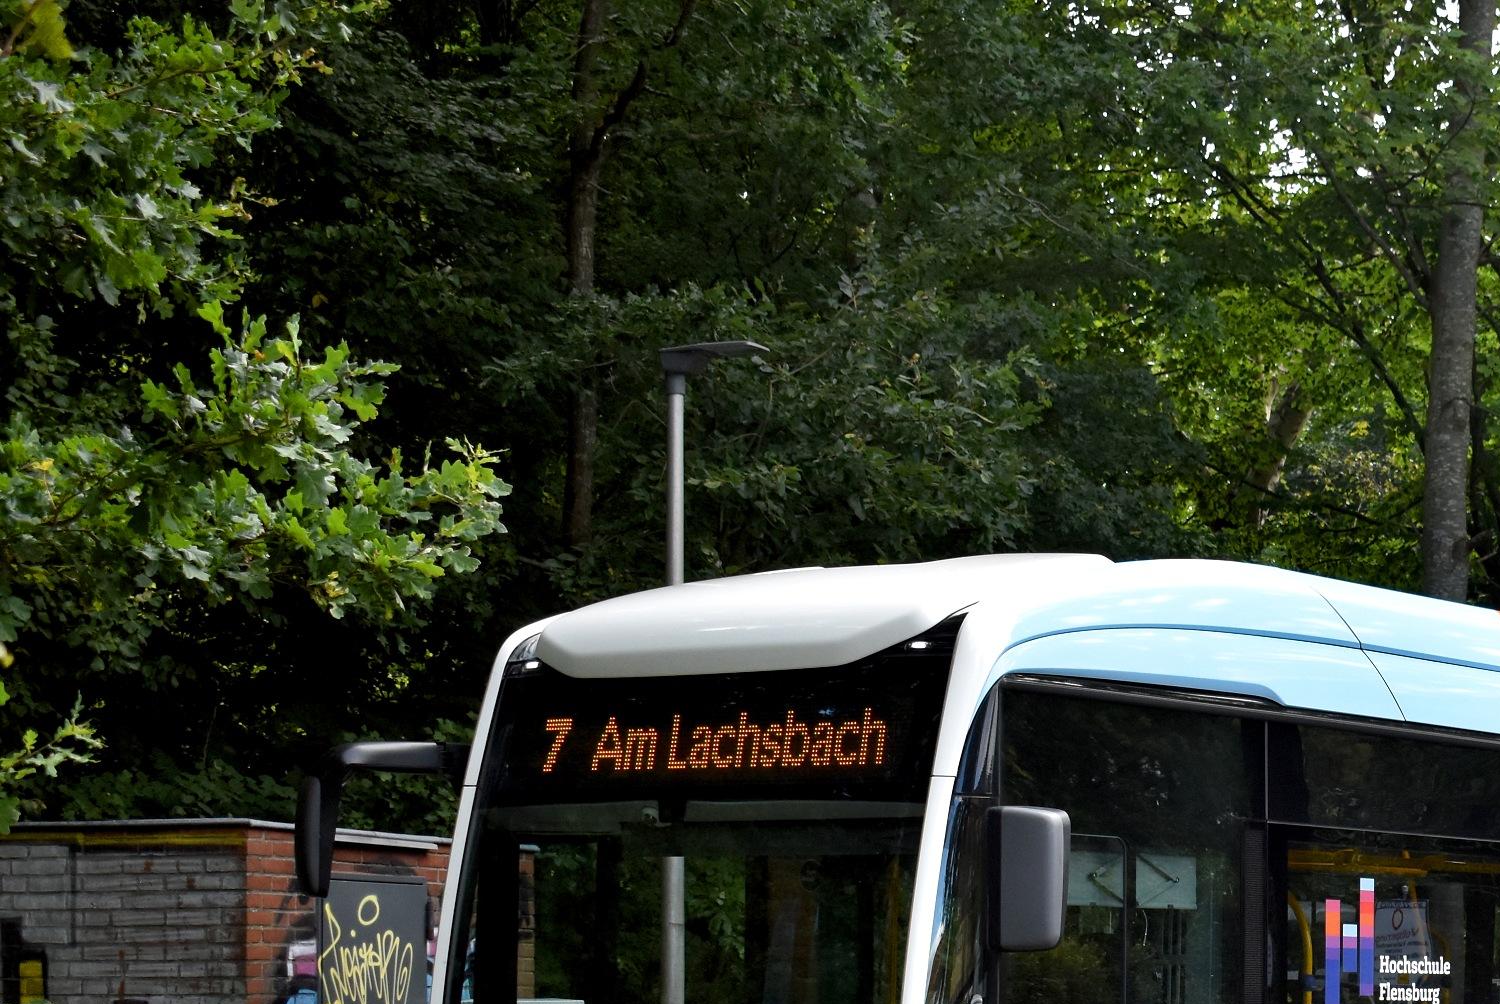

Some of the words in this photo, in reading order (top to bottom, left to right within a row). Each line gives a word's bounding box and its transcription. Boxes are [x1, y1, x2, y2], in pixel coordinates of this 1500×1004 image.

[543, 718, 573, 772] 7
[591, 716, 657, 771] Am
[668, 708, 886, 770] Lachsbach
[1379, 955, 1451, 975] Hochschule
